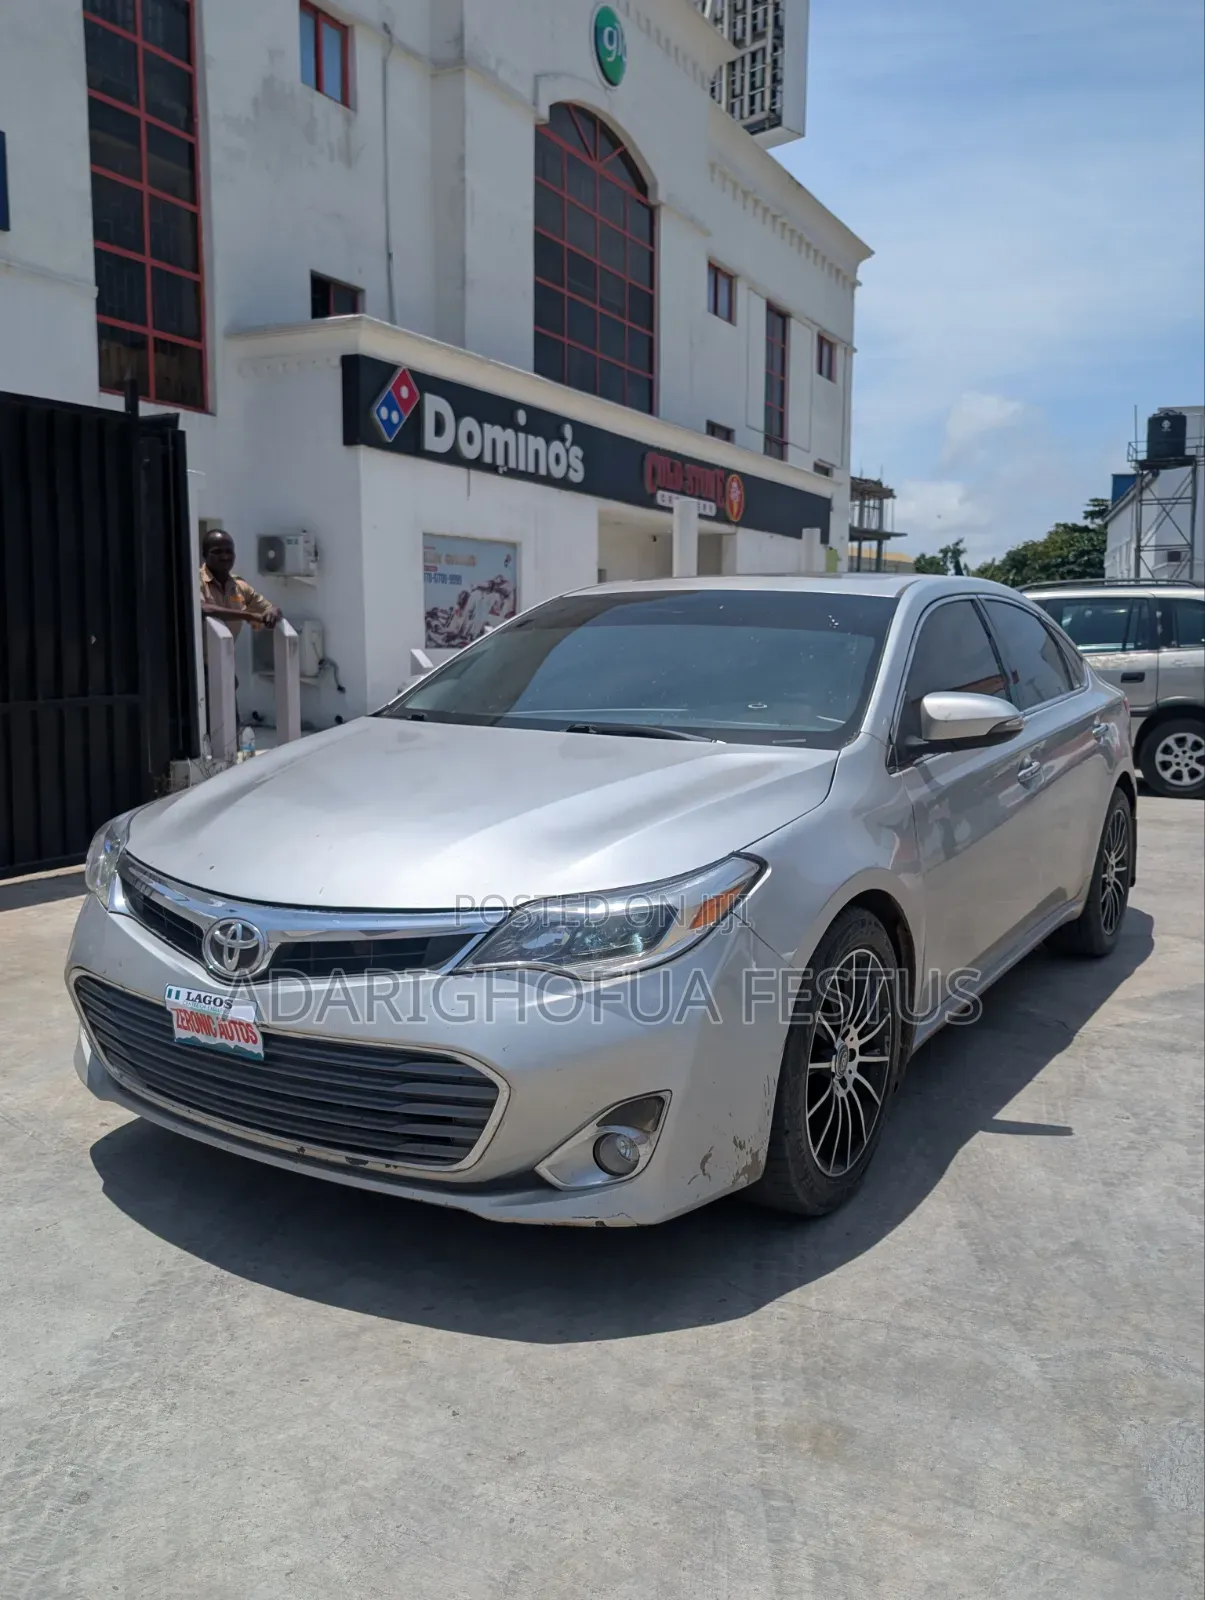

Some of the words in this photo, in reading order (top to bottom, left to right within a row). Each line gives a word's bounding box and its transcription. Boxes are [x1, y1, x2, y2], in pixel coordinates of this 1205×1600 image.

[423, 391, 585, 483] Domino's
[186, 992, 233, 1010] LAGOS
[174, 1008, 217, 1038] ZERONIC
[218, 1020, 258, 1045] AUTOS
